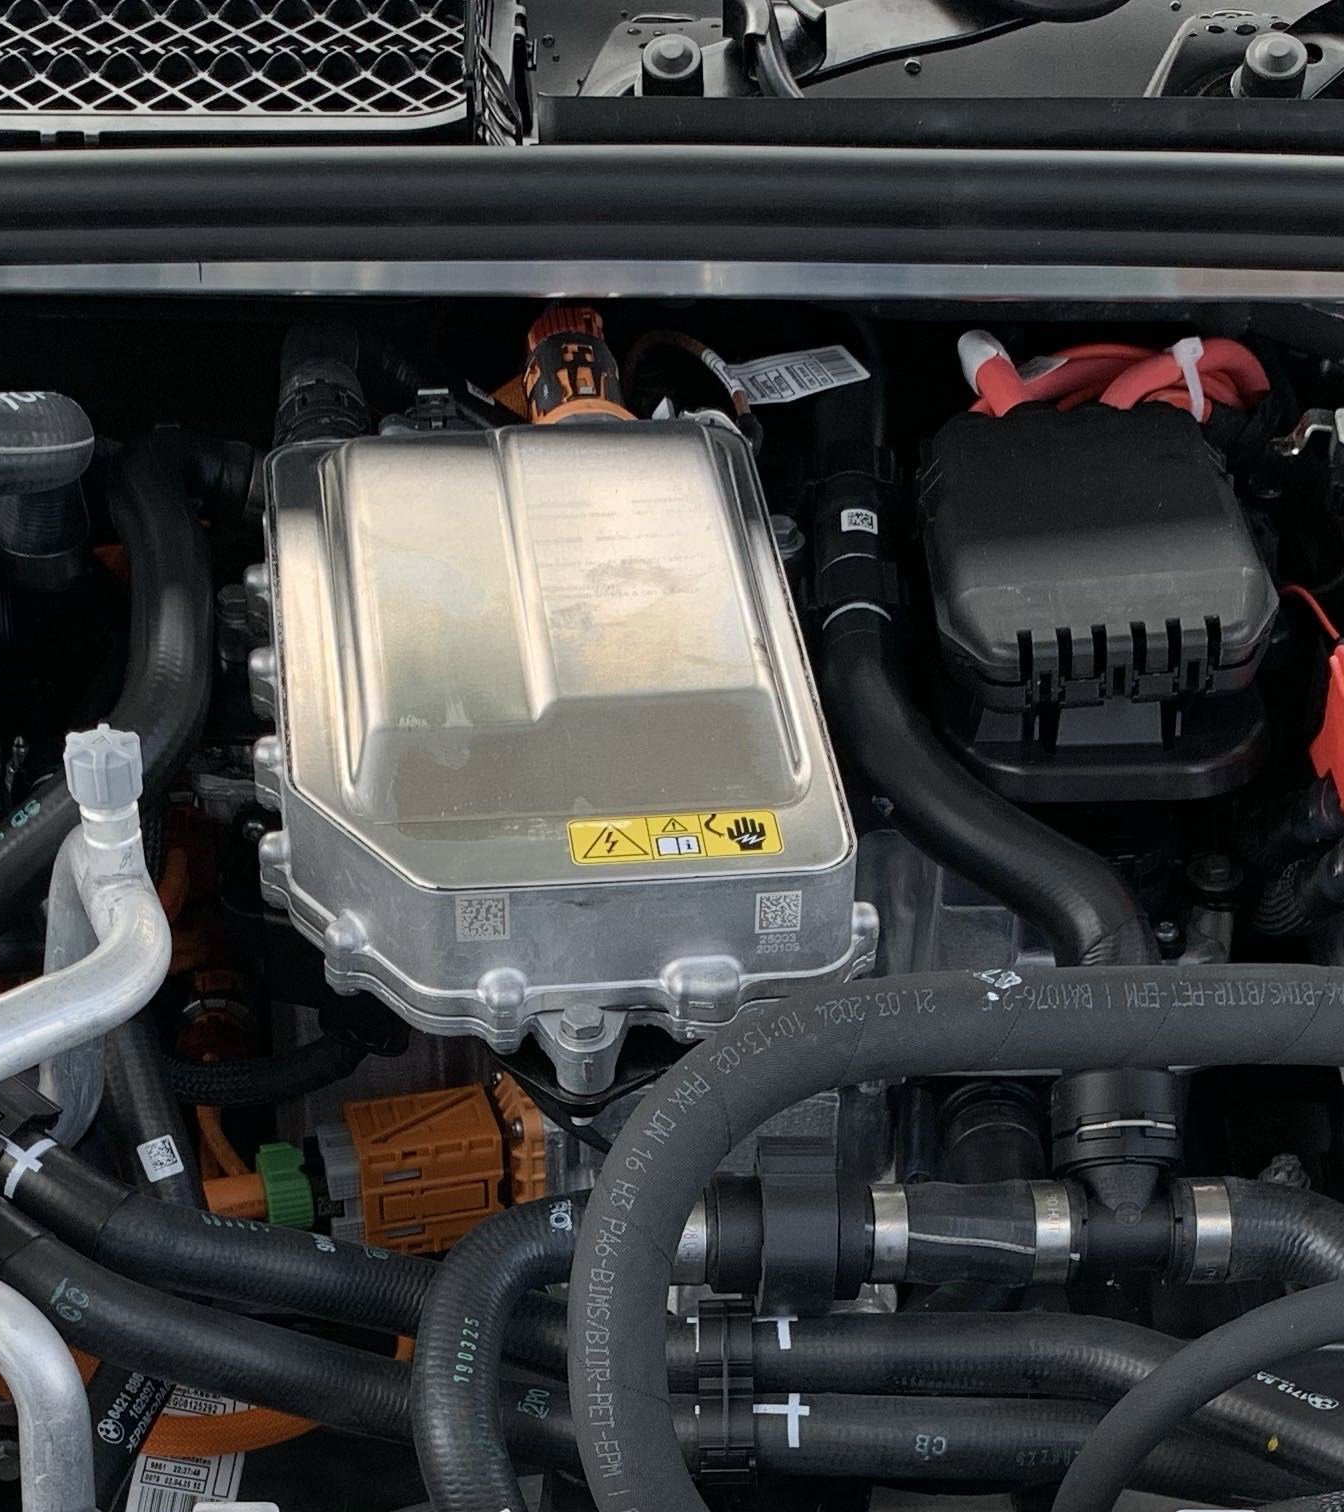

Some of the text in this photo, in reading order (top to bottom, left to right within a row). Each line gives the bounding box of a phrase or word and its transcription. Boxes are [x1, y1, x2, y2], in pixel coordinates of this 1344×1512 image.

[815, 988, 936, 1026] 21.03.2024
[642, 1110, 676, 1144] DN
[625, 1147, 653, 1173] 16
[609, 1178, 640, 1212] H3
[108, 1391, 132, 1421] 6421
[914, 1432, 947, 1456] CB
